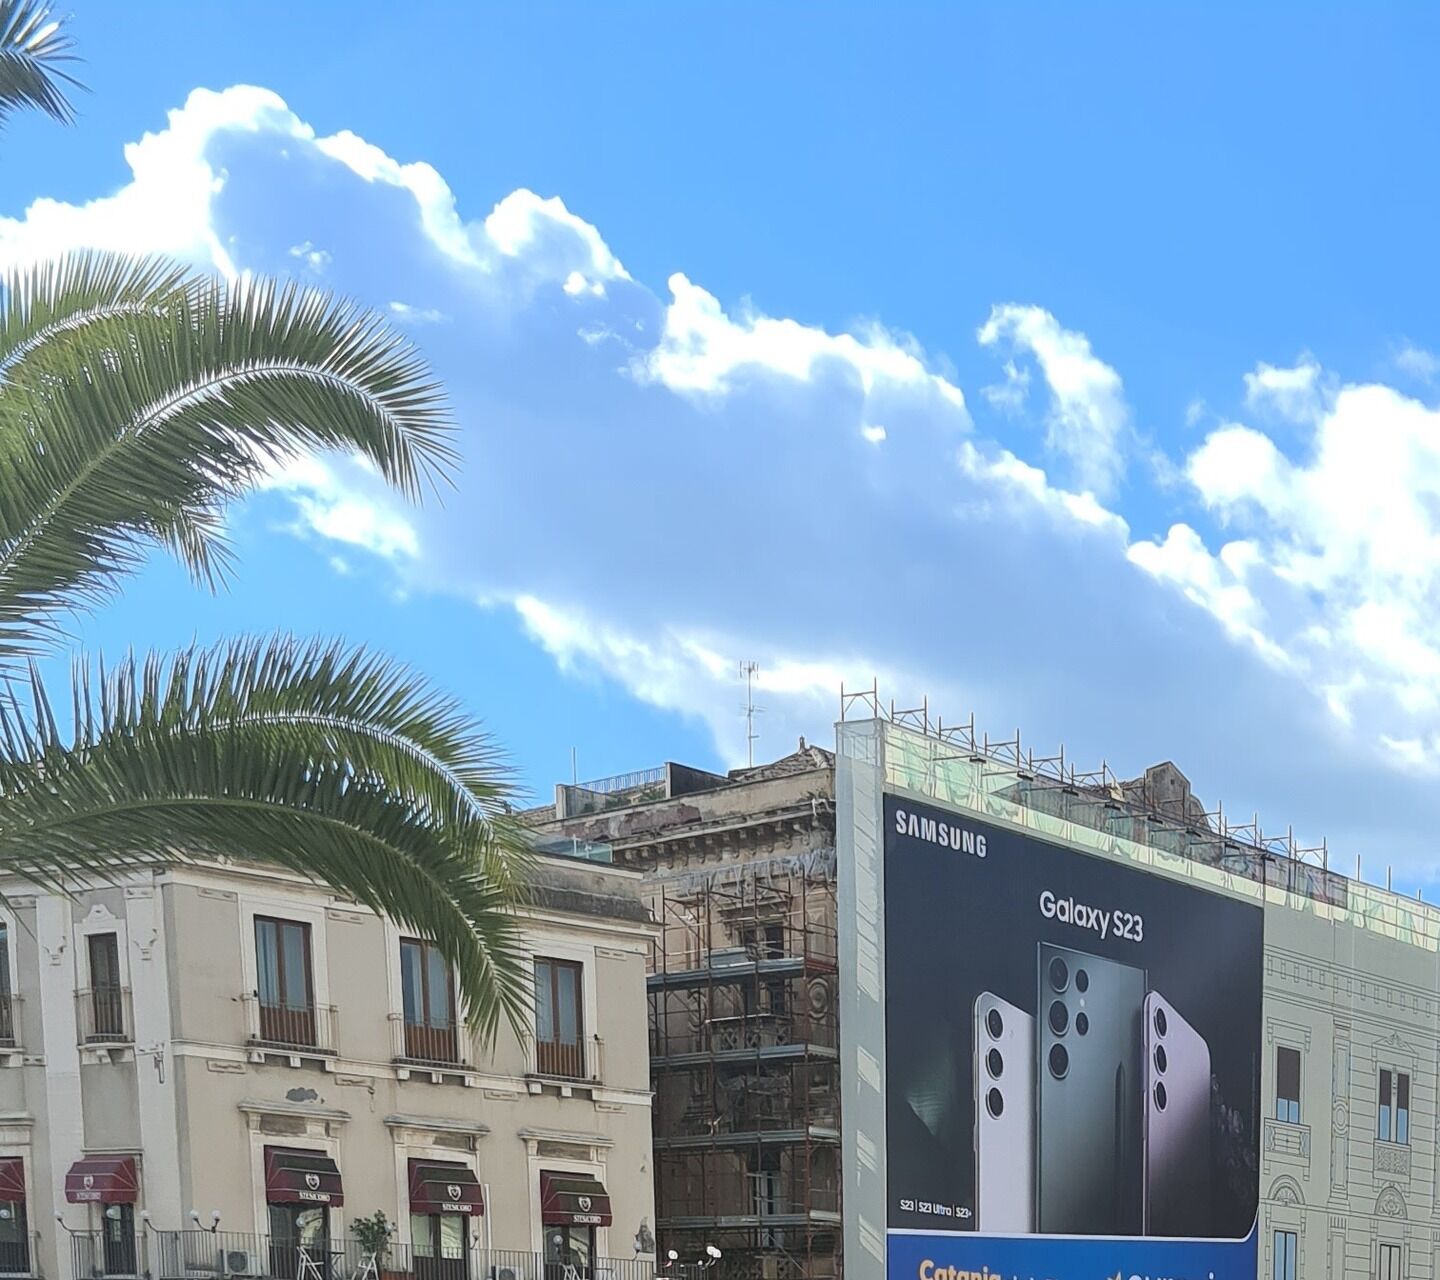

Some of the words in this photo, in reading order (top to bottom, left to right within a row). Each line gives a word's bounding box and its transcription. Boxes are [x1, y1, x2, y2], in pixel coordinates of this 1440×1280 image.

[895, 809, 987, 858] SAMSUNG
[1039, 890, 1110, 939] Galaxy
[1112, 911, 1145, 942] S23
[900, 1199, 914, 1211] S23
[919, 1201, 932, 1214] S23
[933, 1203, 952, 1216] Ultra
